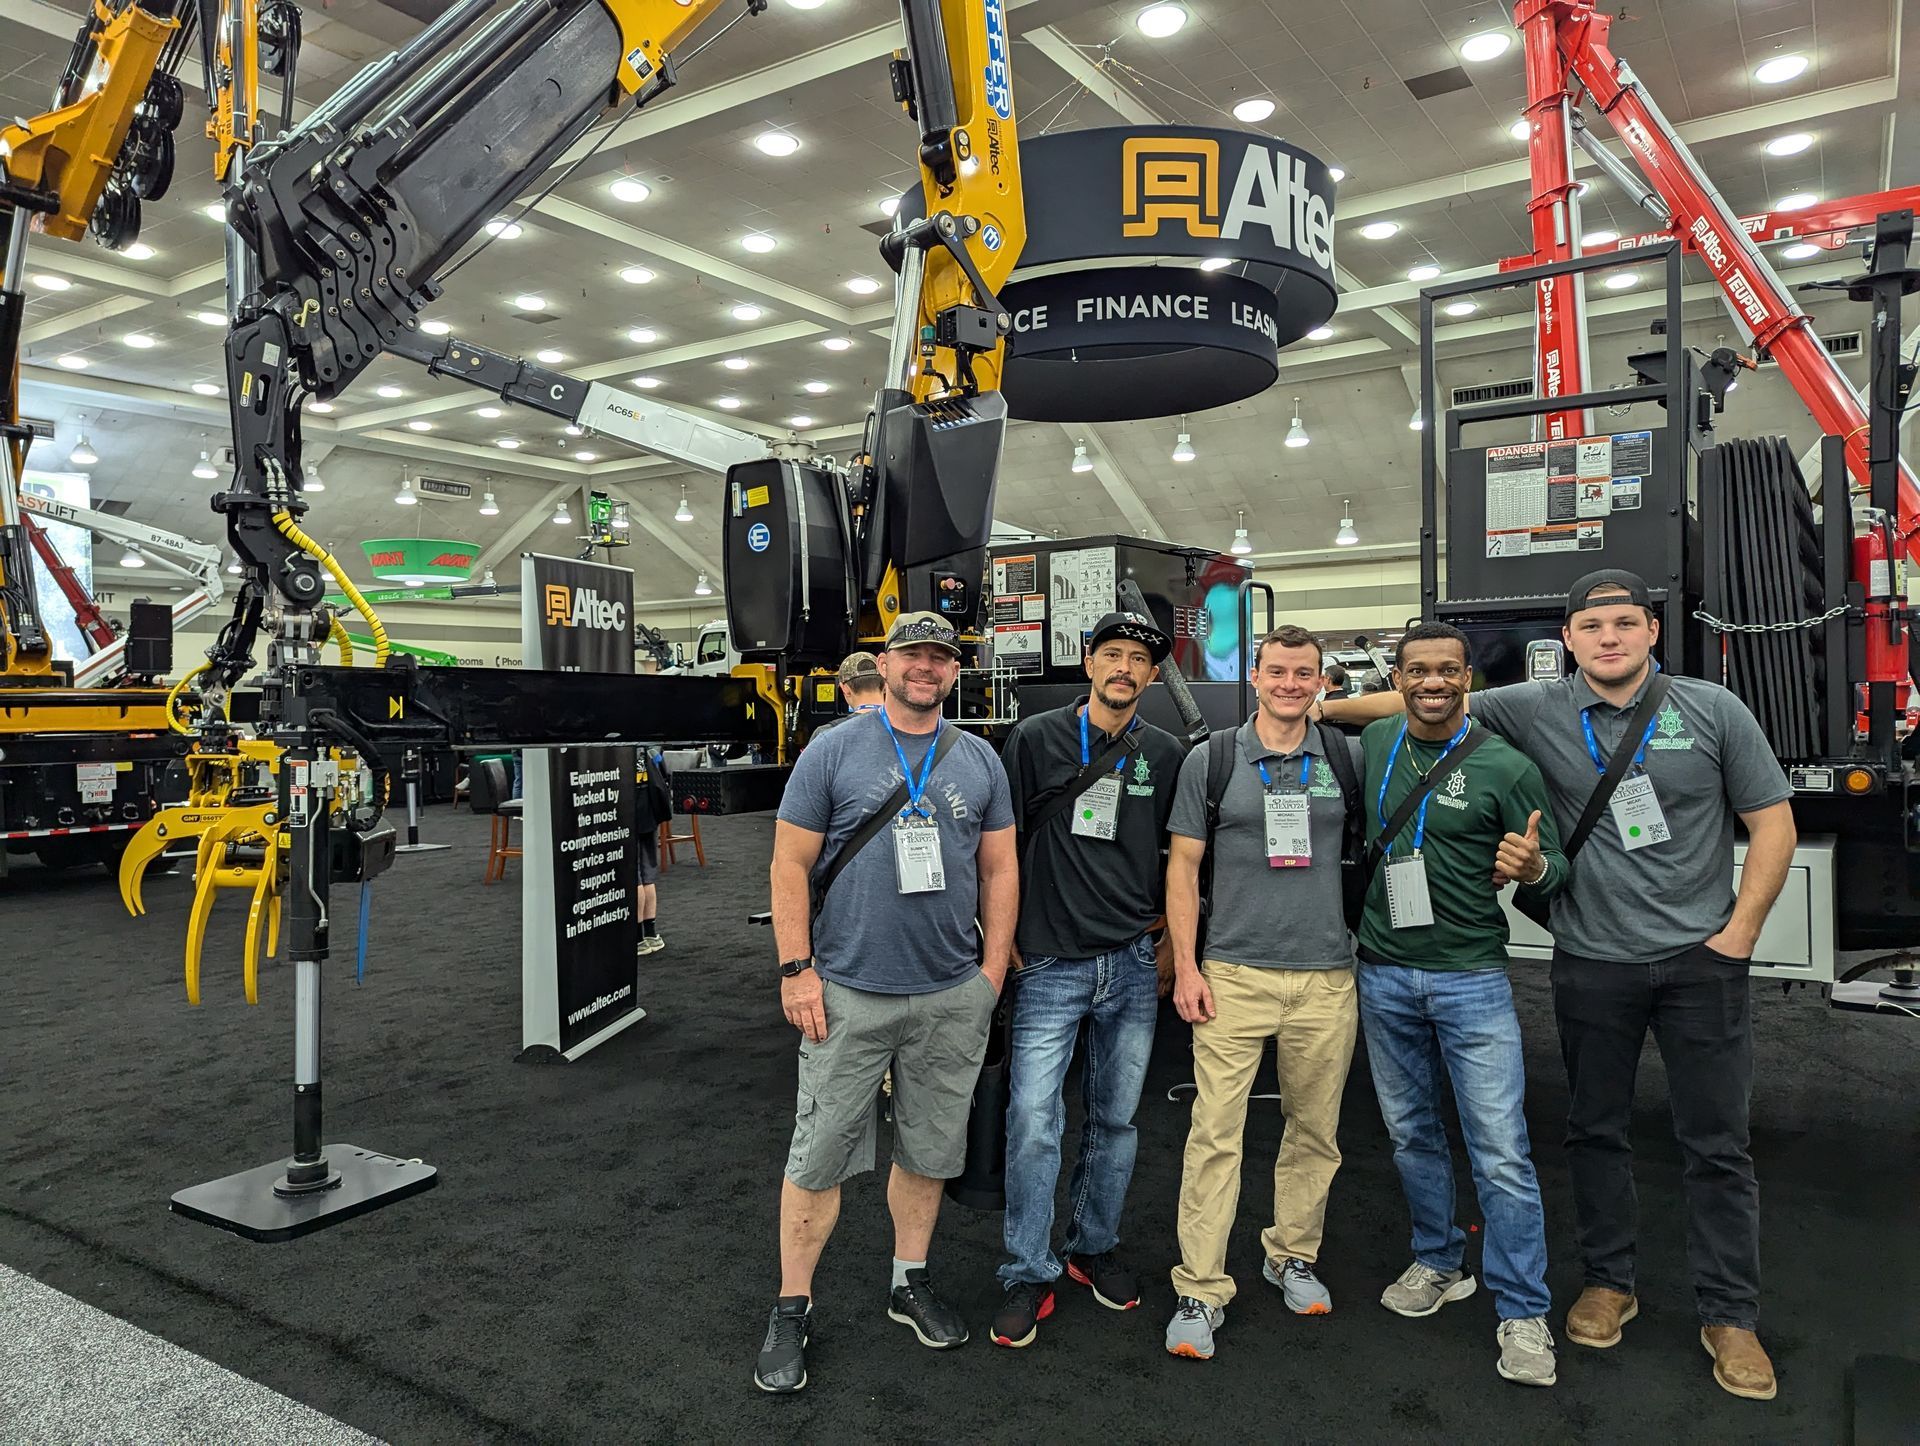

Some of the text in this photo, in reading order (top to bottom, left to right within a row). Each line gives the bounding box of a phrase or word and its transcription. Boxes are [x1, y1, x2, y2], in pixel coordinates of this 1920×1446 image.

[988, 134, 1001, 176] Altec
[1725, 267, 1771, 326] TEUPEN
[1077, 294, 1209, 323] FINANCE
[1231, 301, 1279, 349] LEASIN
[550, 384, 565, 401] C
[1497, 444, 1544, 458] DANGER
[571, 587, 626, 632] Altec
[569, 766, 621, 788] Equipment
[573, 786, 620, 808] backed by
[577, 809, 617, 827] the most
[560, 826, 630, 853] comprehensive
[572, 846, 624, 872] service and
[580, 868, 616, 892] support
[572, 886, 626, 915] organization
[566, 904, 630, 939] in the industry.
[568, 982, 631, 1027] www.altec.com
